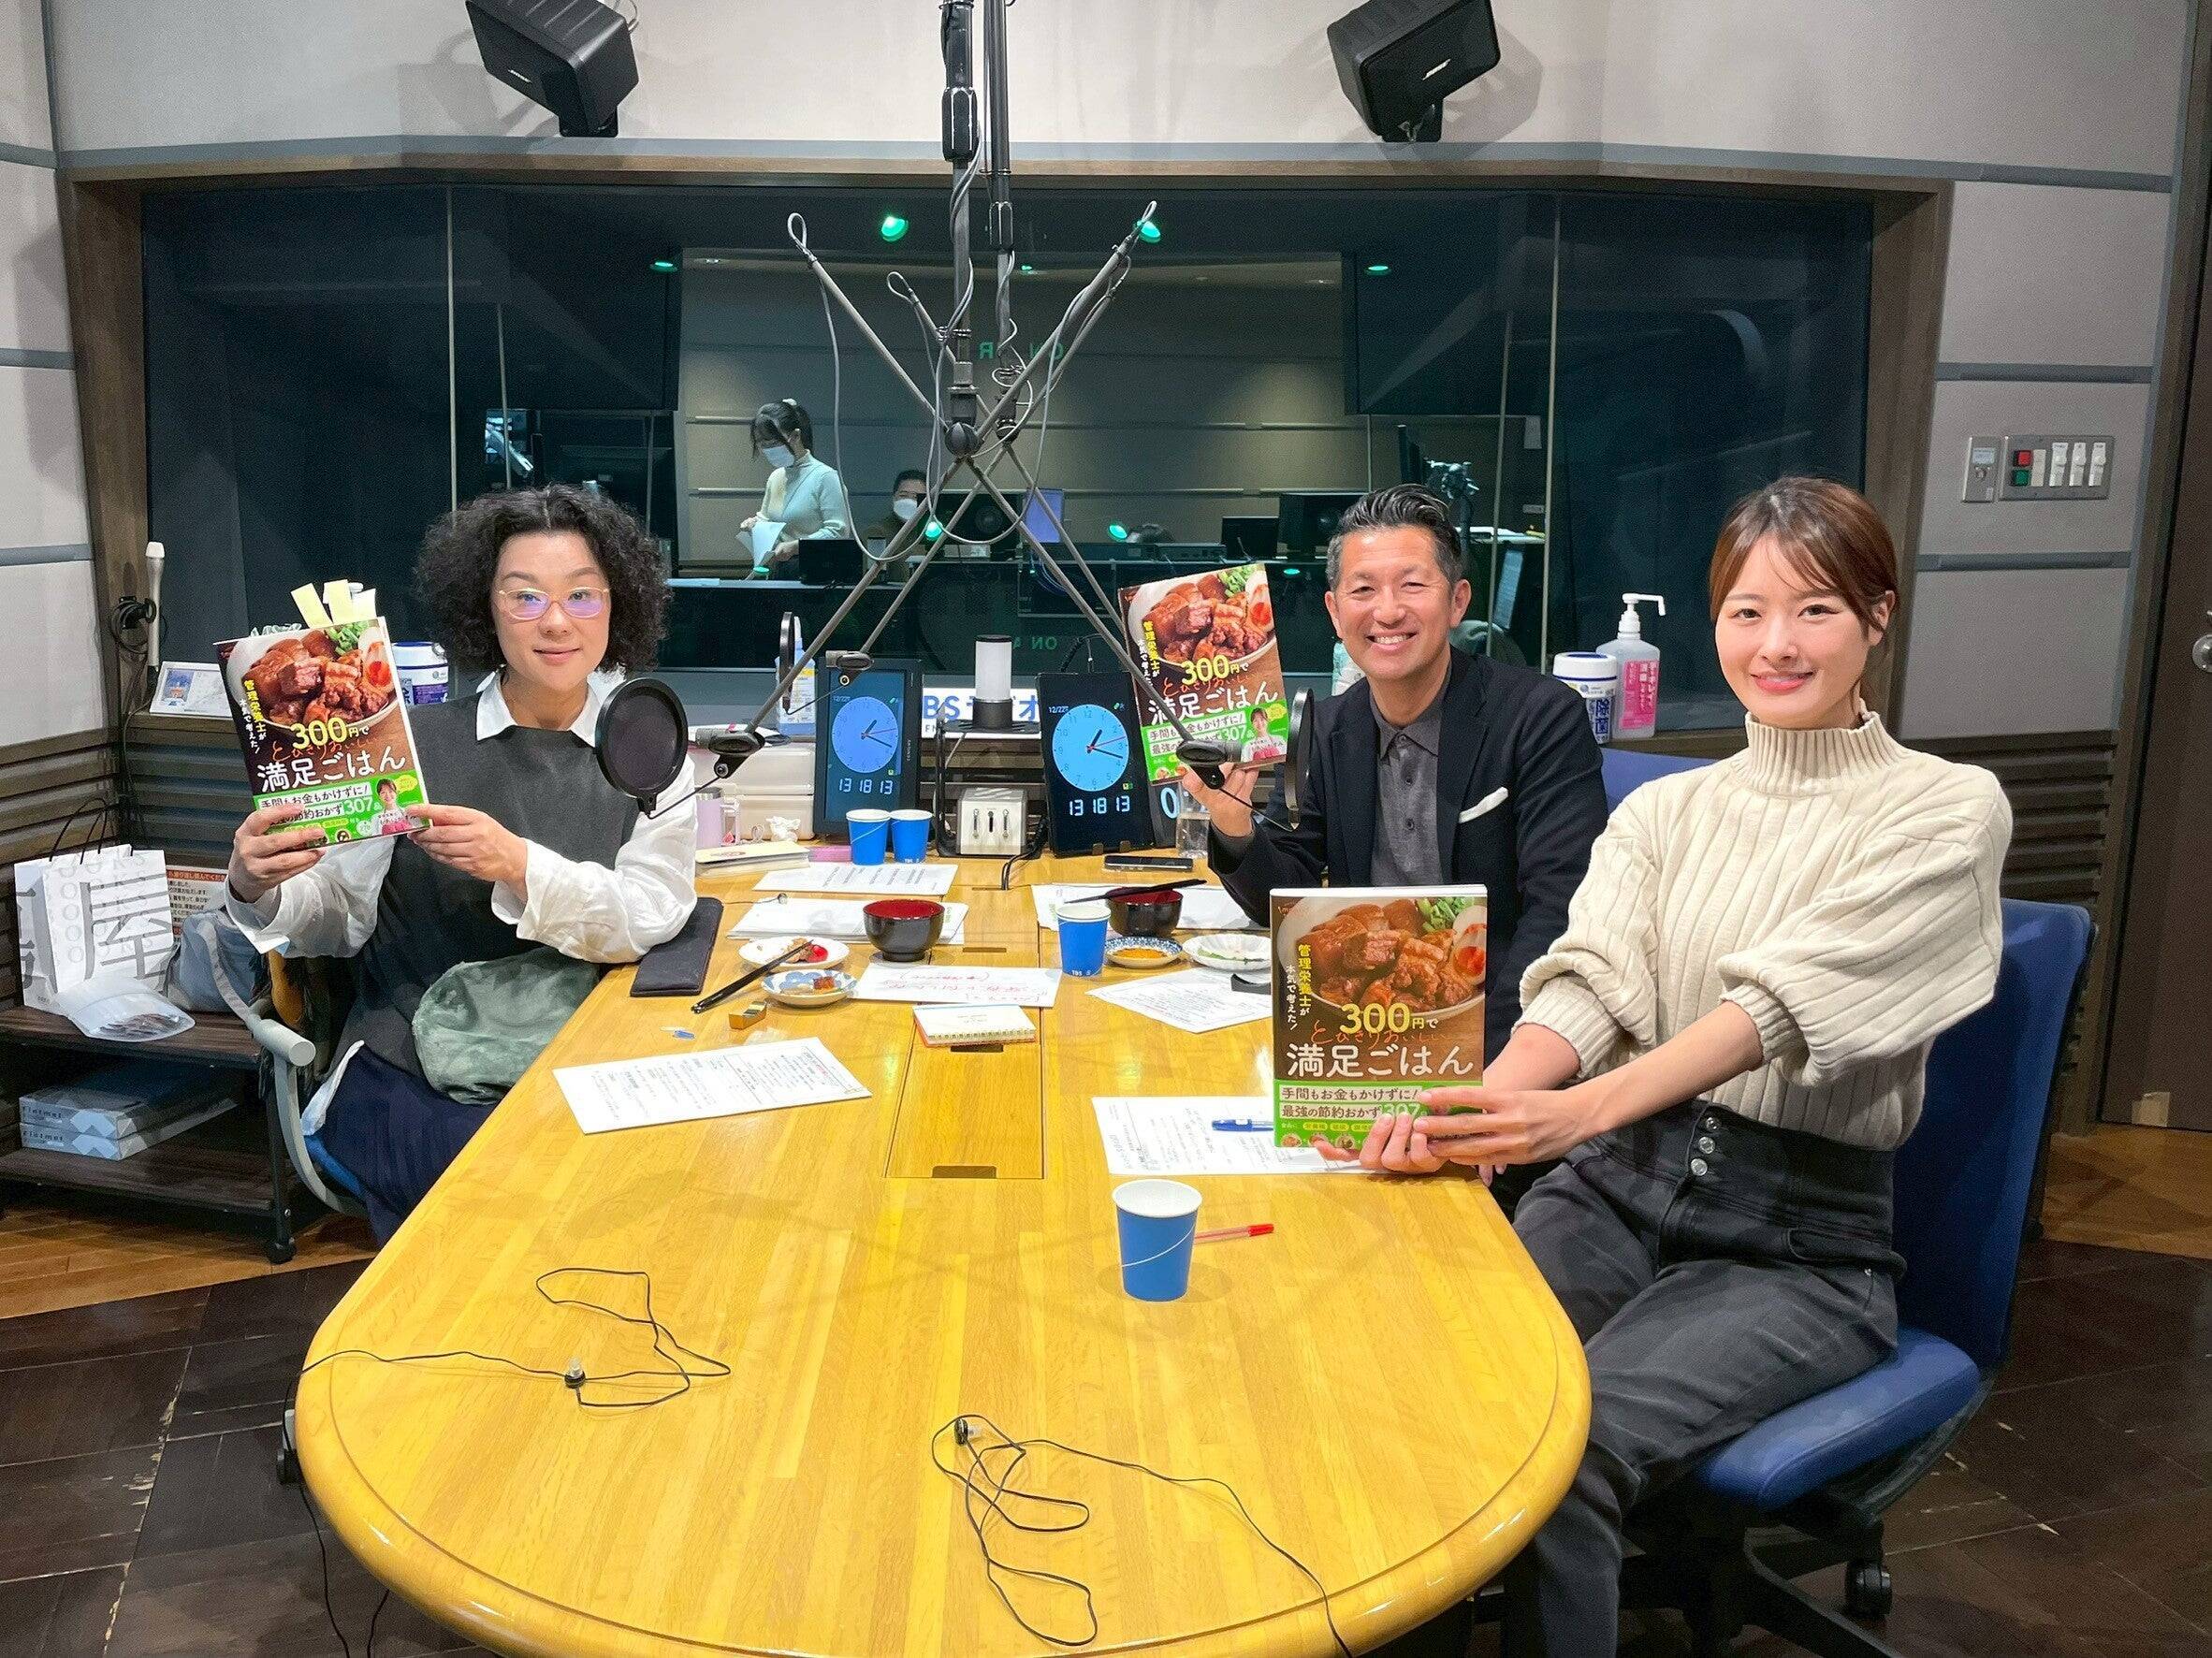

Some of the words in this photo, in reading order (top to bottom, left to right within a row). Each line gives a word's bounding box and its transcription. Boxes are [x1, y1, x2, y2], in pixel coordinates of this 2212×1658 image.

[256, 746, 406, 793] 満足ごはん
[839, 778, 852, 793] 13
[859, 778, 872, 794] 18
[880, 779, 894, 795] 13
[1070, 799, 1084, 816] 13
[1093, 797, 1107, 814] 18
[1116, 795, 1130, 813] 13
[1298, 944, 1312, 1016] 管理栄養士が
[1339, 1003, 1439, 1034] 300円で
[1286, 1043, 1474, 1078] 満足ごはん
